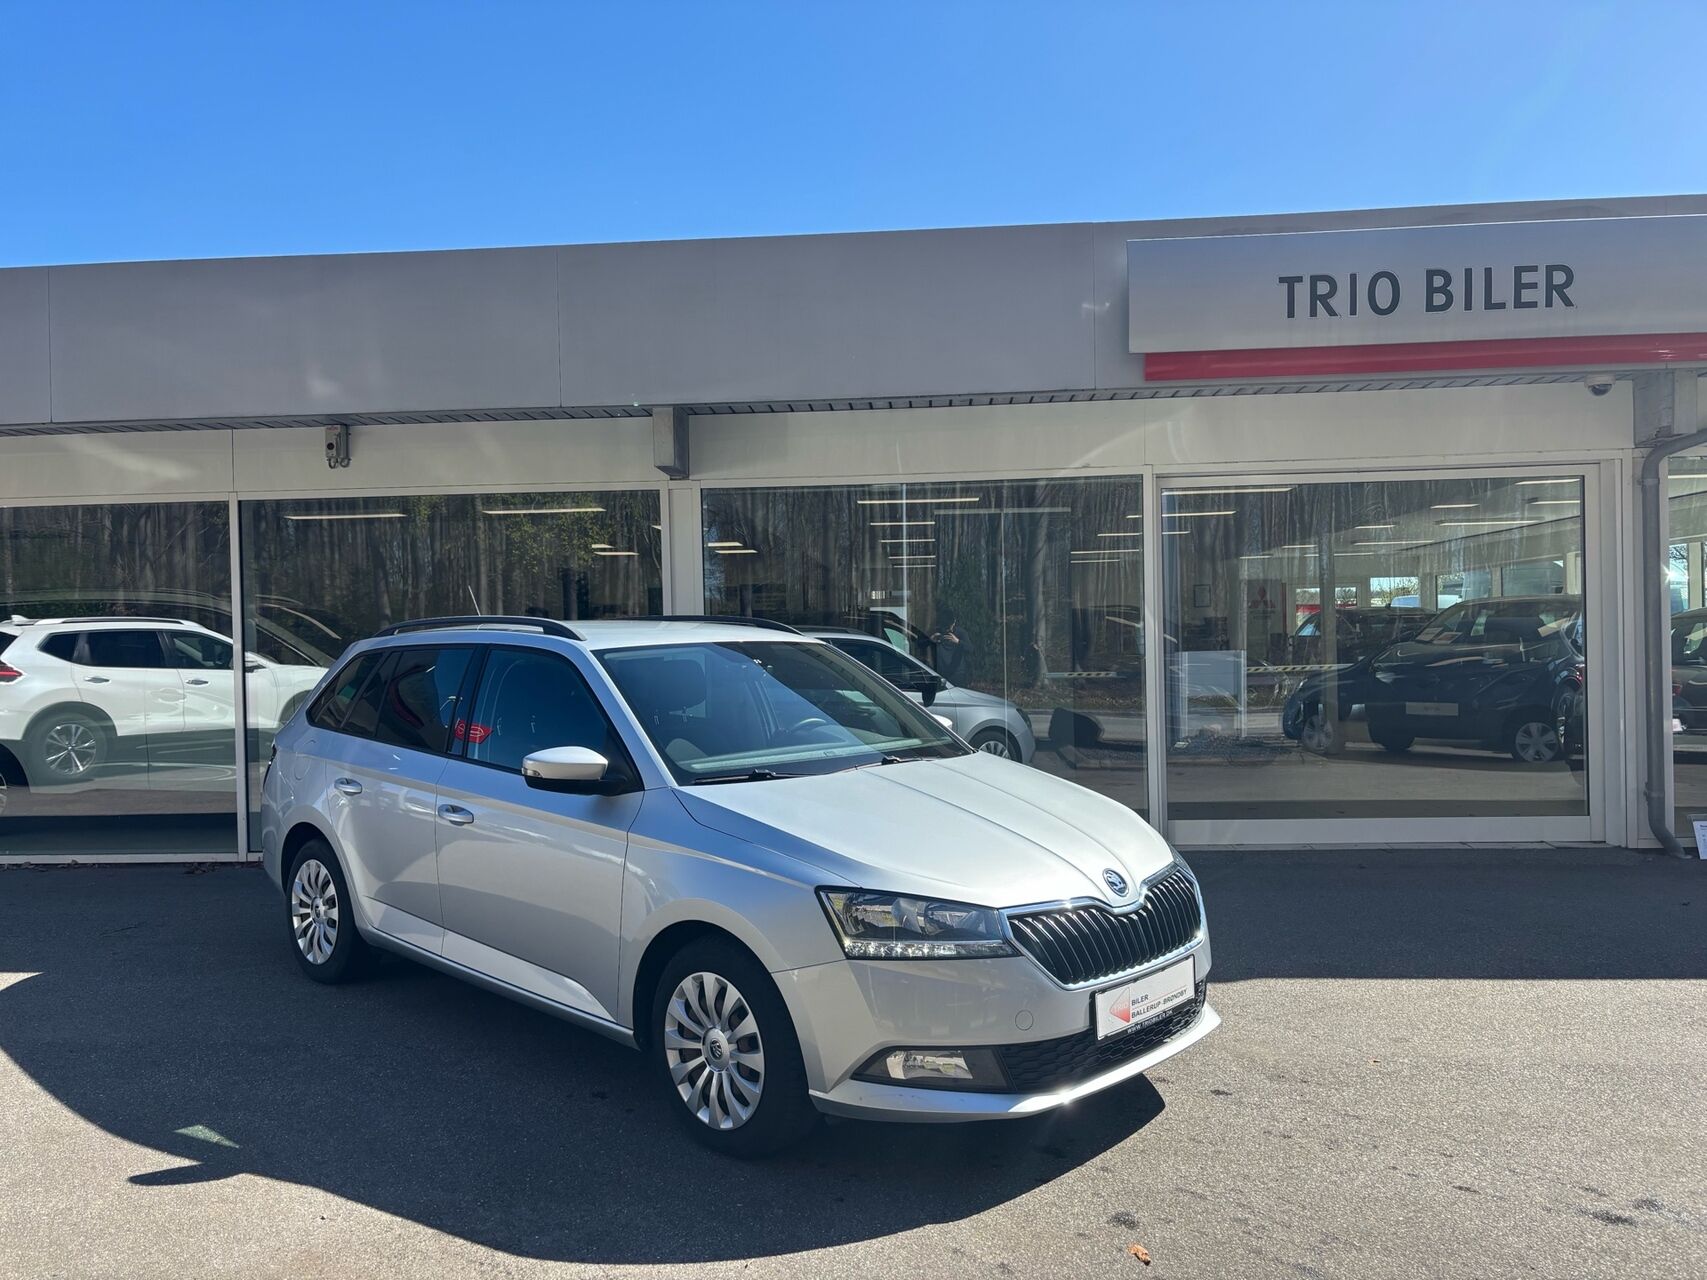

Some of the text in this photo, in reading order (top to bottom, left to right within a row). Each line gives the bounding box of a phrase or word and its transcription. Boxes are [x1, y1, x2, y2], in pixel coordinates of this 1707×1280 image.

[1278, 264, 1575, 318] TRIO BILER
[1131, 994, 1149, 1006] BILER
